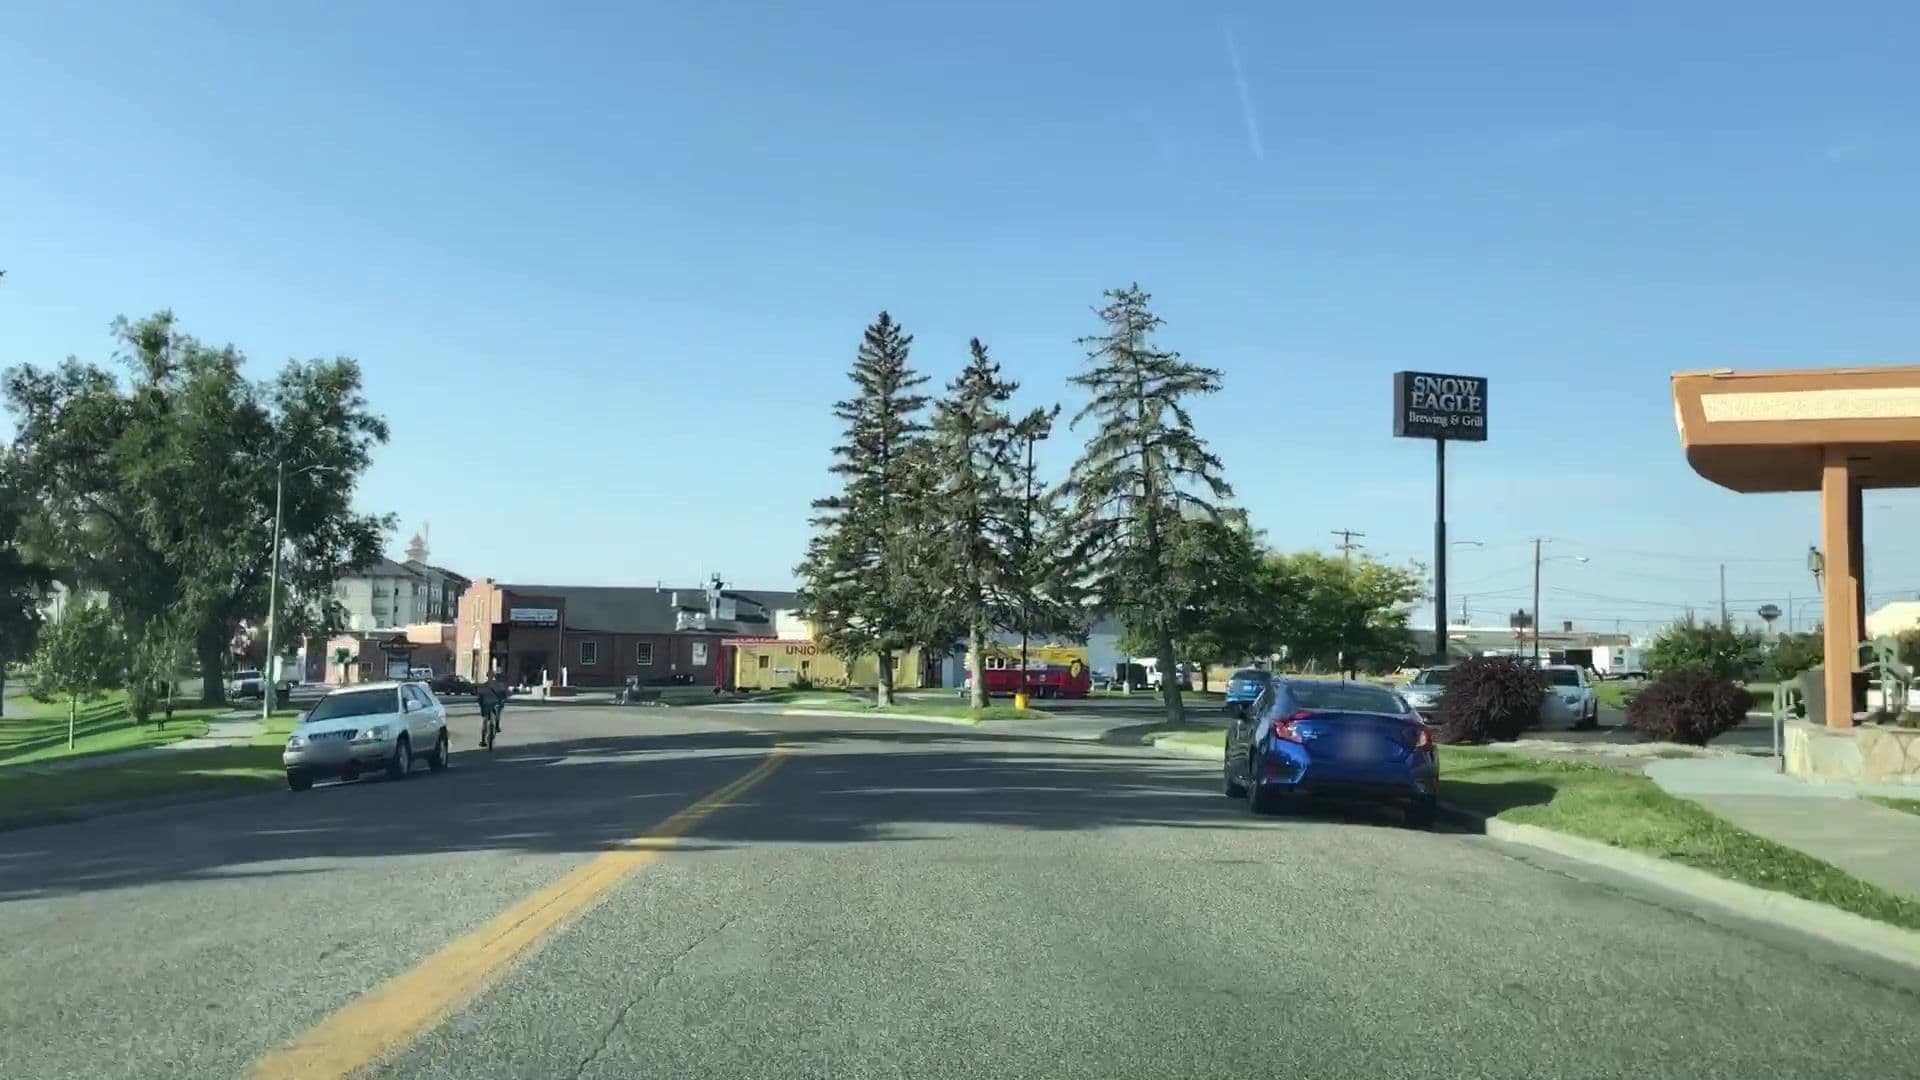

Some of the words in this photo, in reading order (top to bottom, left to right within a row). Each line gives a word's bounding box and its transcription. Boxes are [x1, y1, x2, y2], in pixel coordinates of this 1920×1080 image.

[1413, 376, 1479, 396] SNOW
[1410, 391, 1481, 413] EAGLE
[1408, 411, 1448, 428] Brewing
[1450, 414, 1459, 426] &
[1462, 415, 1483, 427] Grill
